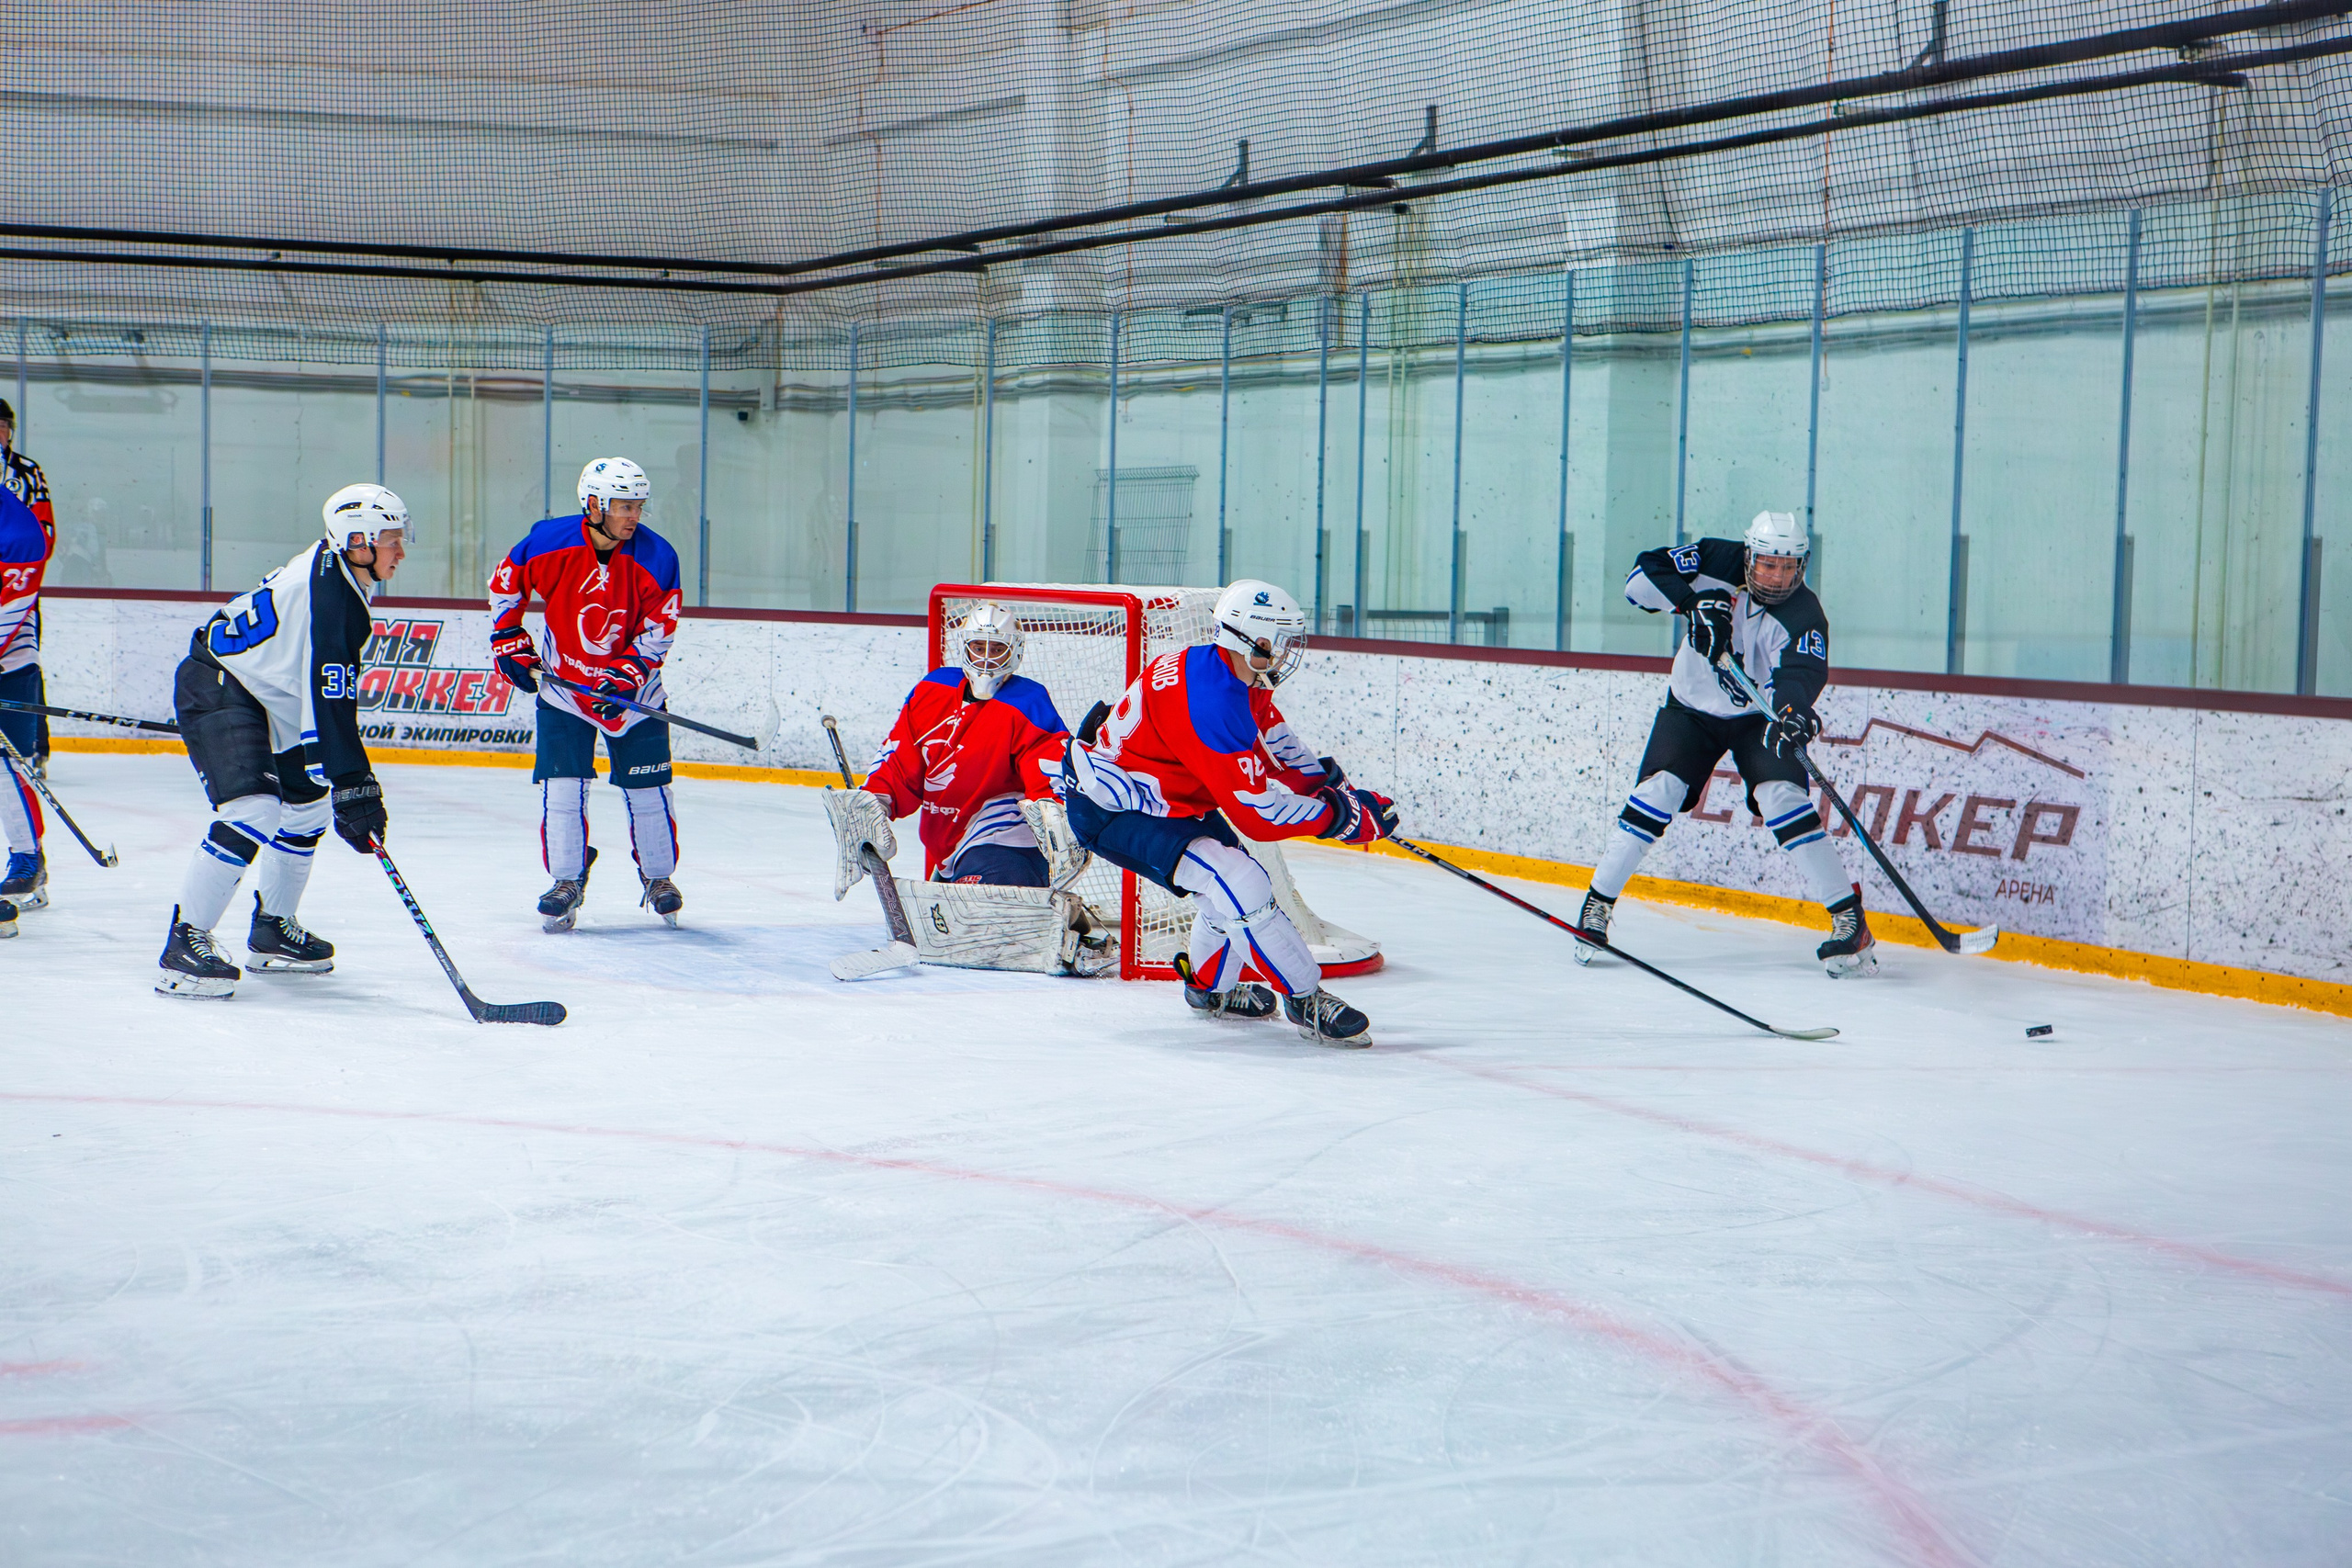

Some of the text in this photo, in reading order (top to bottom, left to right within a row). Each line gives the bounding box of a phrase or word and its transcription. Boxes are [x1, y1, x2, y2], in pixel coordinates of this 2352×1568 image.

[1668, 545, 1700, 574] 13
[1696, 600, 1731, 611] CC
[209, 584, 280, 658] 3
[359, 620, 444, 665] МЯ
[492, 637, 531, 657] CCM
[1796, 629, 1826, 660] 13
[356, 667, 514, 715] ОККЕЯ
[357, 722, 533, 745] НОЙ ЭКИПИРОВКИ
[333, 785, 381, 806] BAUE
[1995, 878, 2054, 906] АРЕНА
